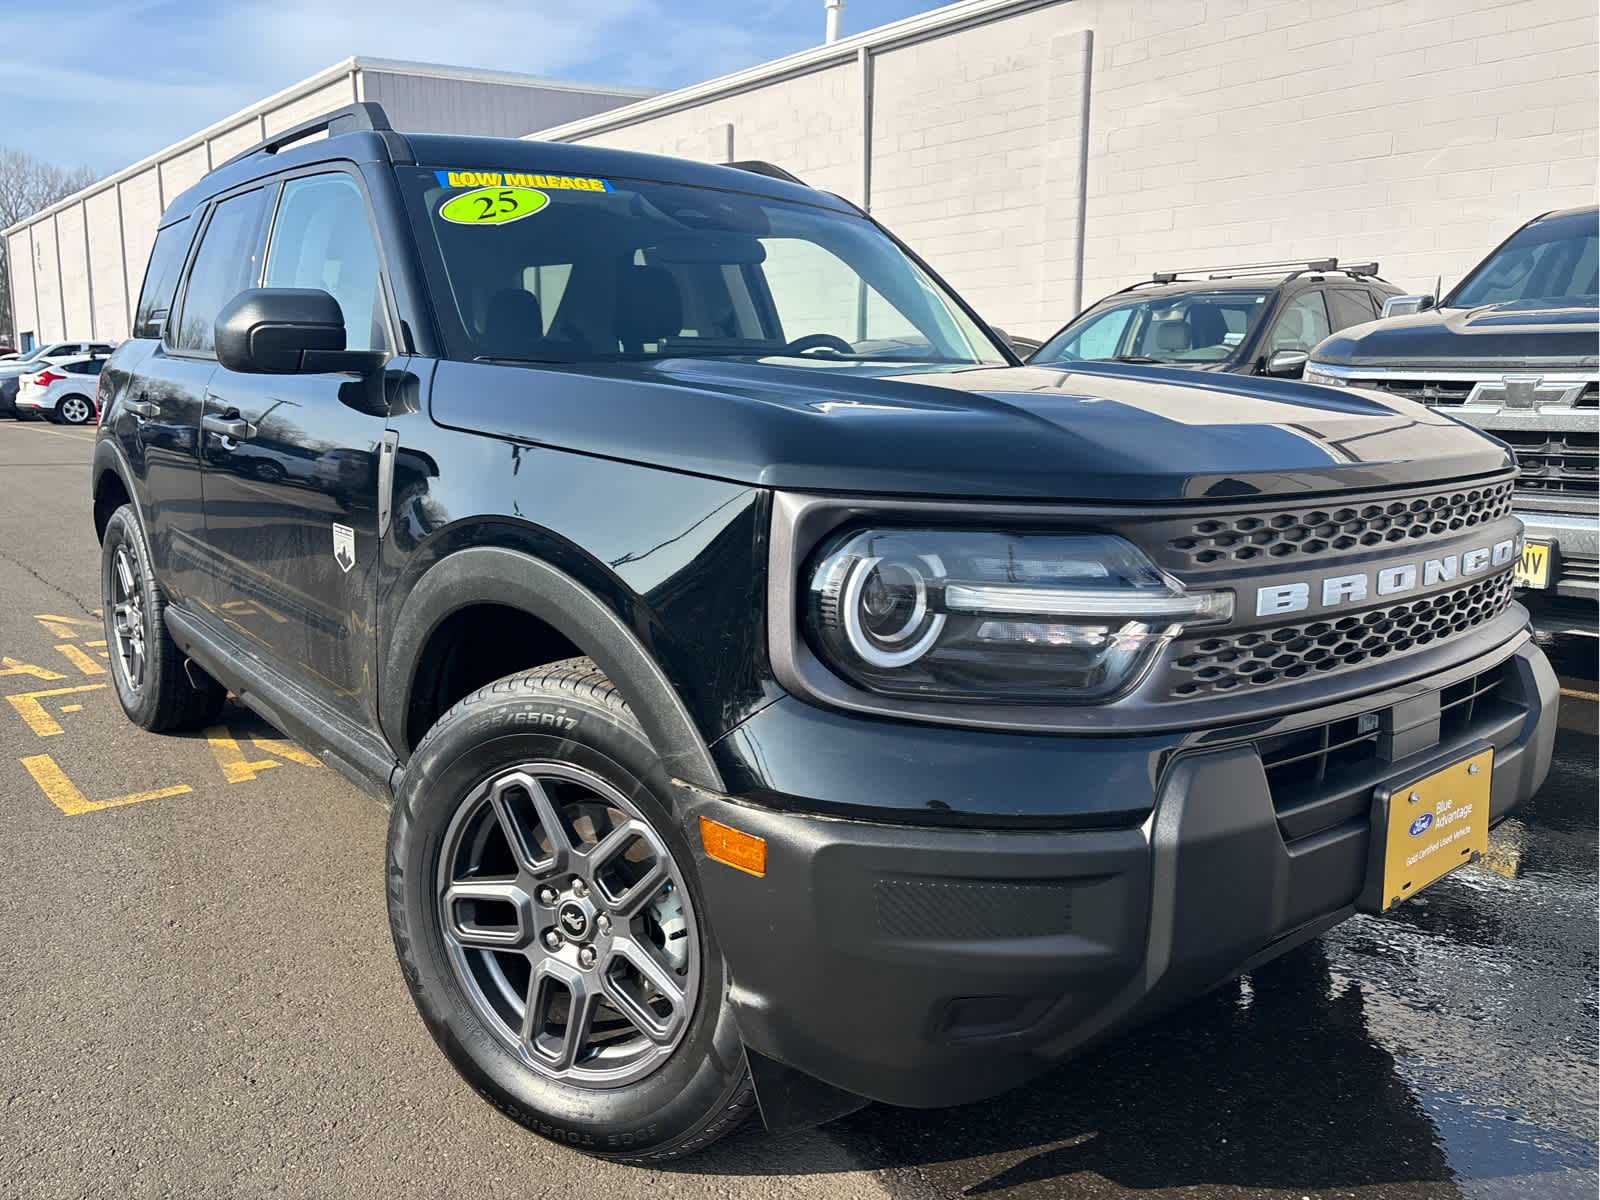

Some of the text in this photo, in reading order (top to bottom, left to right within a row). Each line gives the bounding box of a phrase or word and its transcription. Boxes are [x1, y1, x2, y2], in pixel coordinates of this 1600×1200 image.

[448, 172, 606, 193] LOW MILEAGE
[473, 190, 518, 220] 25
[1256, 540, 1514, 617] BRONCO
[1435, 799, 1453, 815] Blue
[1435, 803, 1473, 831] Advantage
